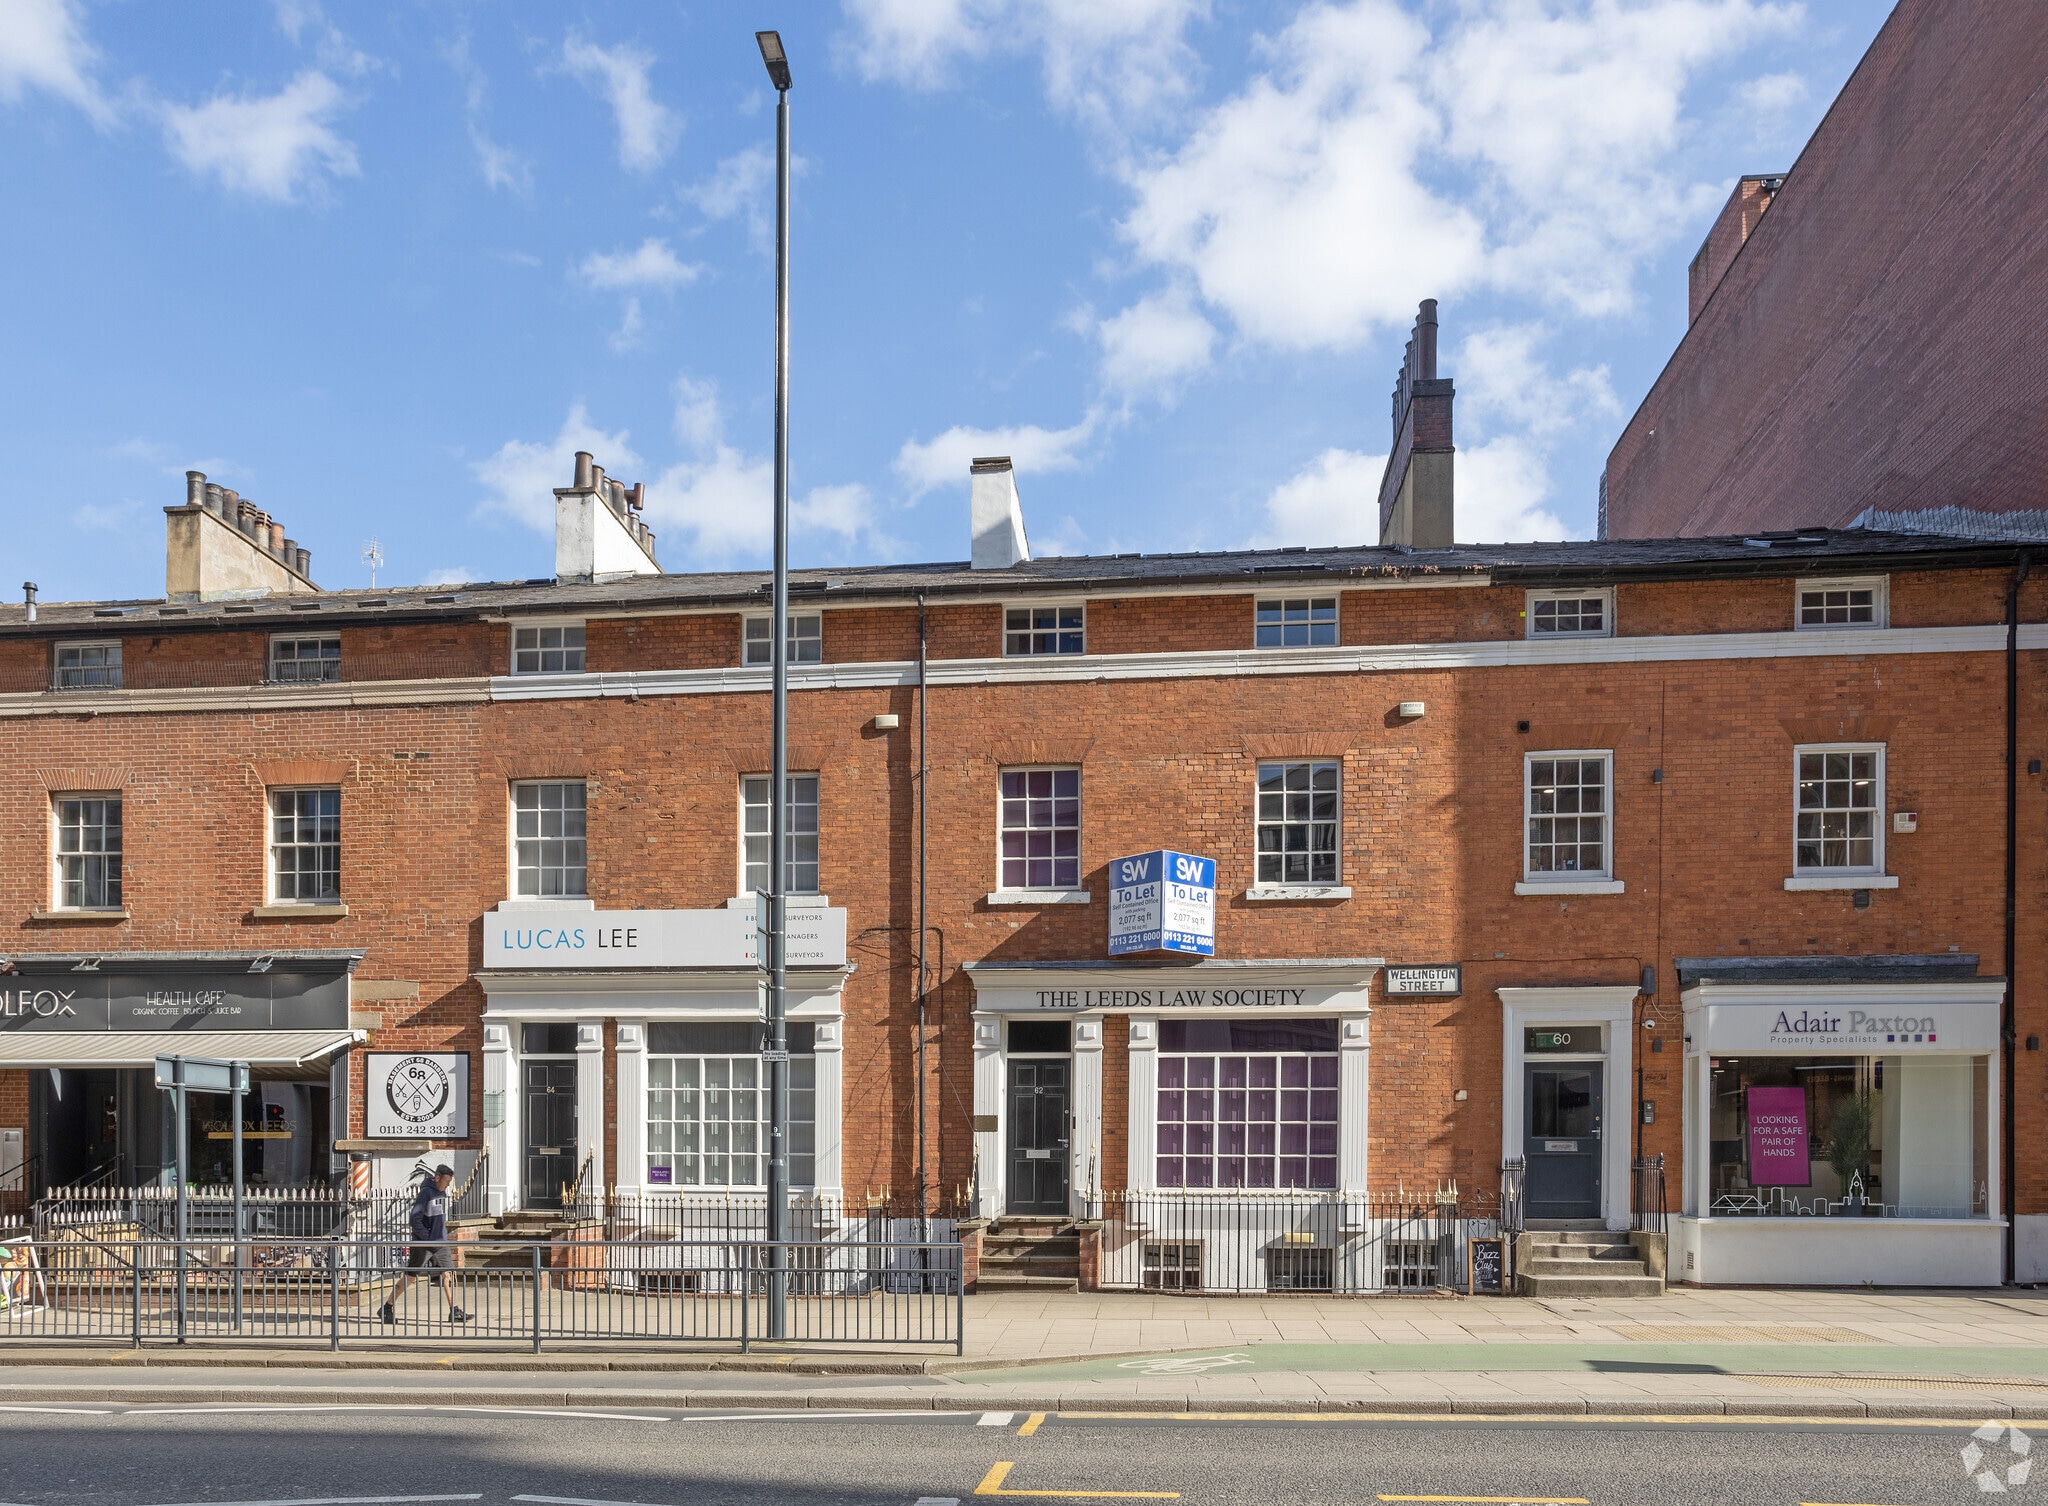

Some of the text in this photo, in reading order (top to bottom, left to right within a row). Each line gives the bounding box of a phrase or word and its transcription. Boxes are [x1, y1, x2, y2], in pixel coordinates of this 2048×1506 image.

[1121, 857, 1149, 883] SW
[1176, 857, 1204, 883] SW
[1117, 884, 1155, 903] To Let
[1171, 883, 1208, 903] To Let
[1112, 898, 1159, 911] Self Contained Office
[1118, 911, 1152, 926] 2,077 sq ft
[1173, 912, 1206, 926] 2,077 sq ft
[503, 928, 638, 949] LUCAS LEE
[1109, 930, 1161, 947] 0113 221 6000
[1163, 931, 1213, 947] 0113 221 6000
[1390, 969, 1456, 980] WELLINGTON
[1399, 980, 1445, 991] STREET
[146, 990, 191, 1006] HEALTH
[1036, 988, 1306, 1008] THE LEEDS LAW SOCIETY
[132, 1007, 157, 1016] ORGANIC
[158, 1007, 180, 1016] COFFEE
[207, 1007, 213, 1015] &
[214, 1006, 229, 1015] JUICE
[230, 1006, 242, 1014] BAR
[1771, 1010, 1936, 1033] Adair Paxton
[1553, 1033, 1571, 1045] 60
[1770, 1035, 1878, 1045] Property Specialists
[388, 1057, 415, 1085] BASEMENT
[424, 1058, 448, 1085] BARBERS
[408, 1067, 426, 1080] 68
[546, 1086, 556, 1094] 64
[1034, 1086, 1044, 1094] 62
[401, 1112, 434, 1121] EST. 2009
[1756, 1115, 1799, 1124] LOOKING
[260, 1120, 297, 1131] LEEDS
[379, 1125, 456, 1135] 0113 242 3322
[1753, 1126, 1803, 1135] FOR A SAFE
[1761, 1137, 1796, 1146] PAIR OF
[1763, 1148, 1796, 1157] HANDS
[1475, 1244, 1500, 1261] Buzz
[1474, 1260, 1494, 1271] Club
